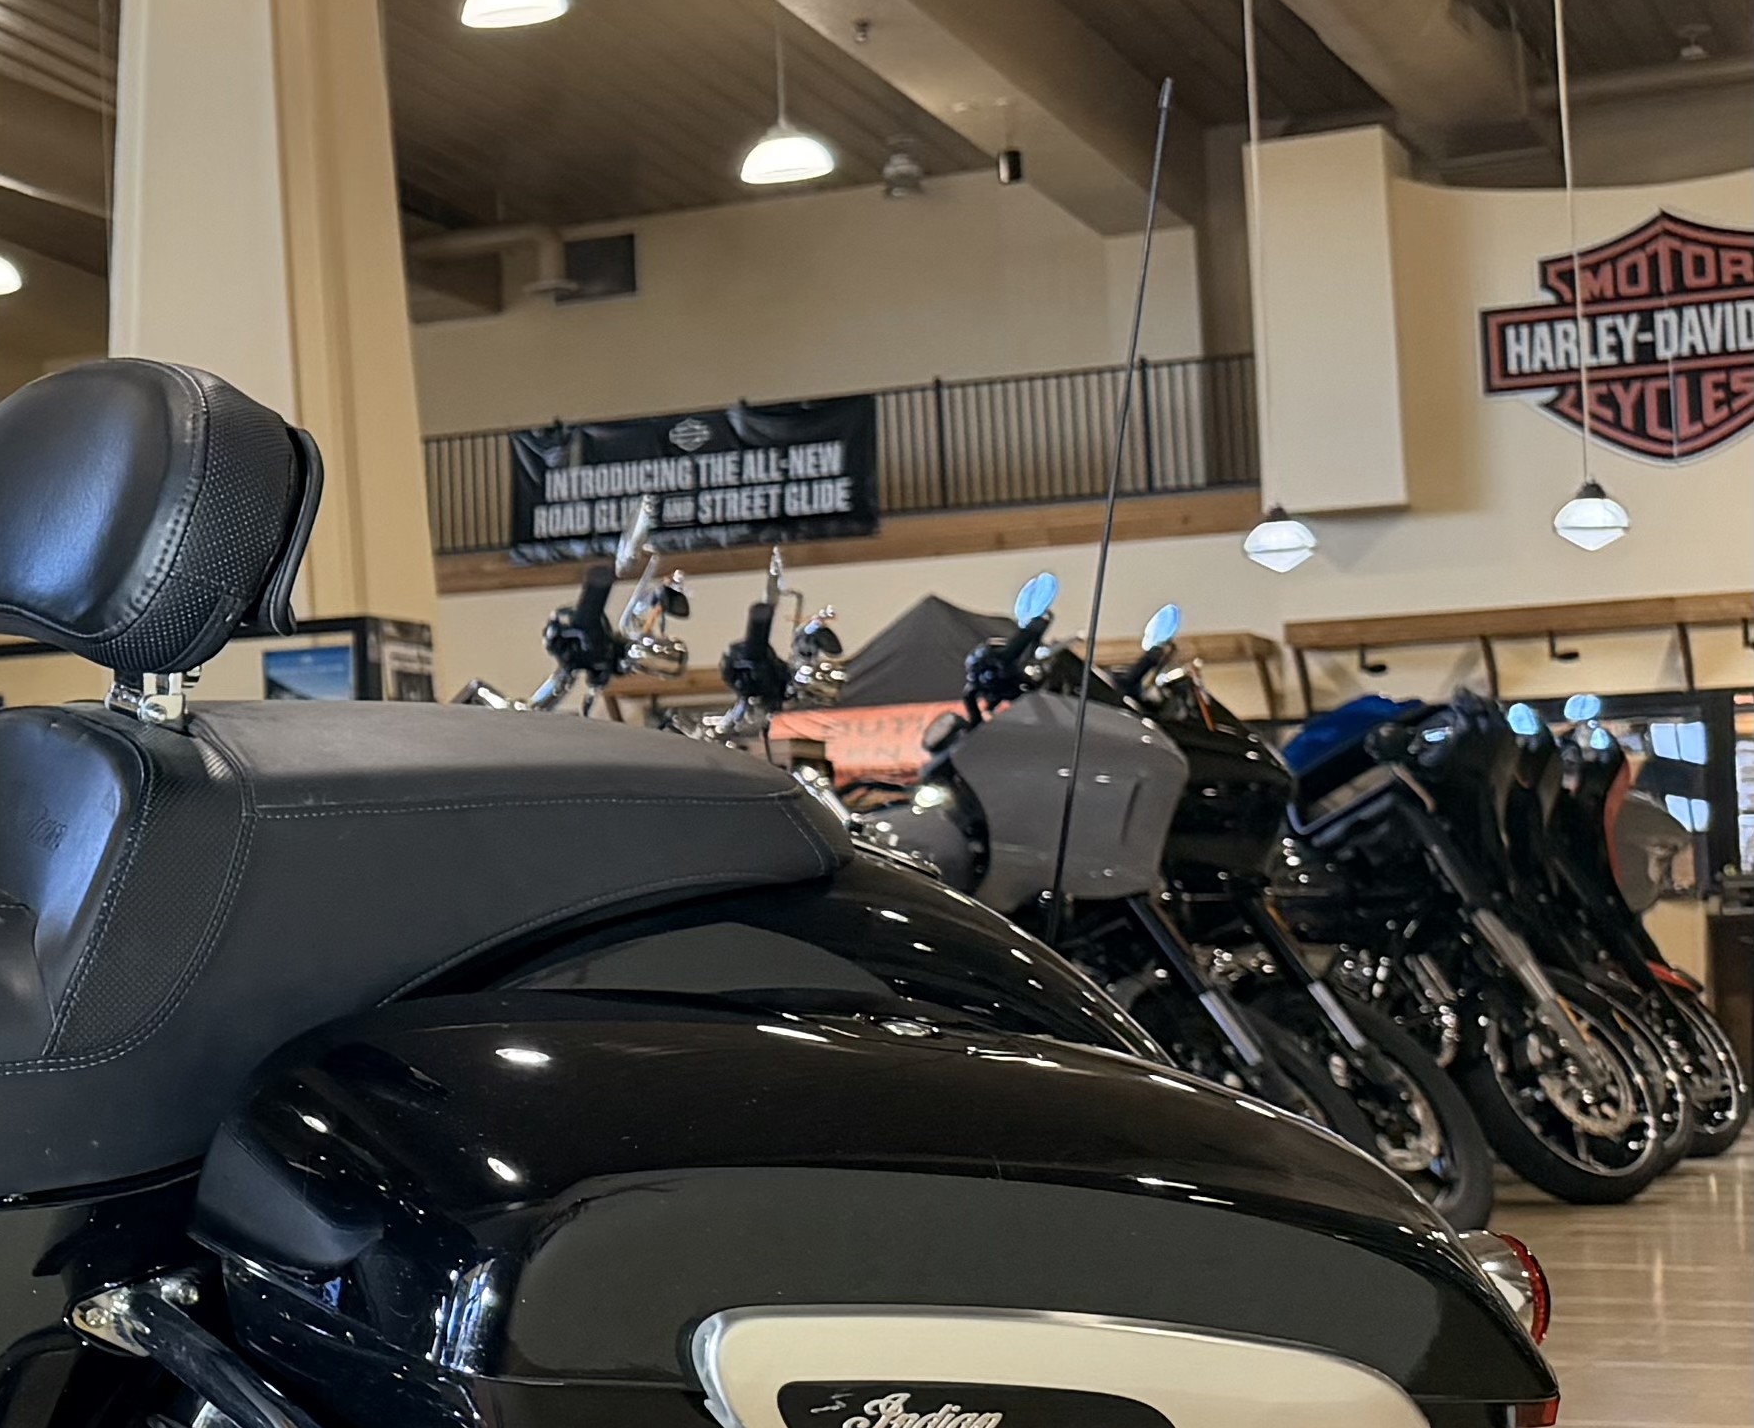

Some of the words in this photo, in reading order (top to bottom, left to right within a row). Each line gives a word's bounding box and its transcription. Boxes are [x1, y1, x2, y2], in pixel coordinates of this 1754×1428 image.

[1577, 233, 1754, 300] MOTOR
[544, 455, 692, 502] INTRODUCING
[695, 451, 739, 487] THE
[742, 439, 842, 483] ALL-NEW
[533, 501, 591, 539] ROAD
[697, 483, 782, 523] STREET
[784, 475, 852, 516] GLIDE
